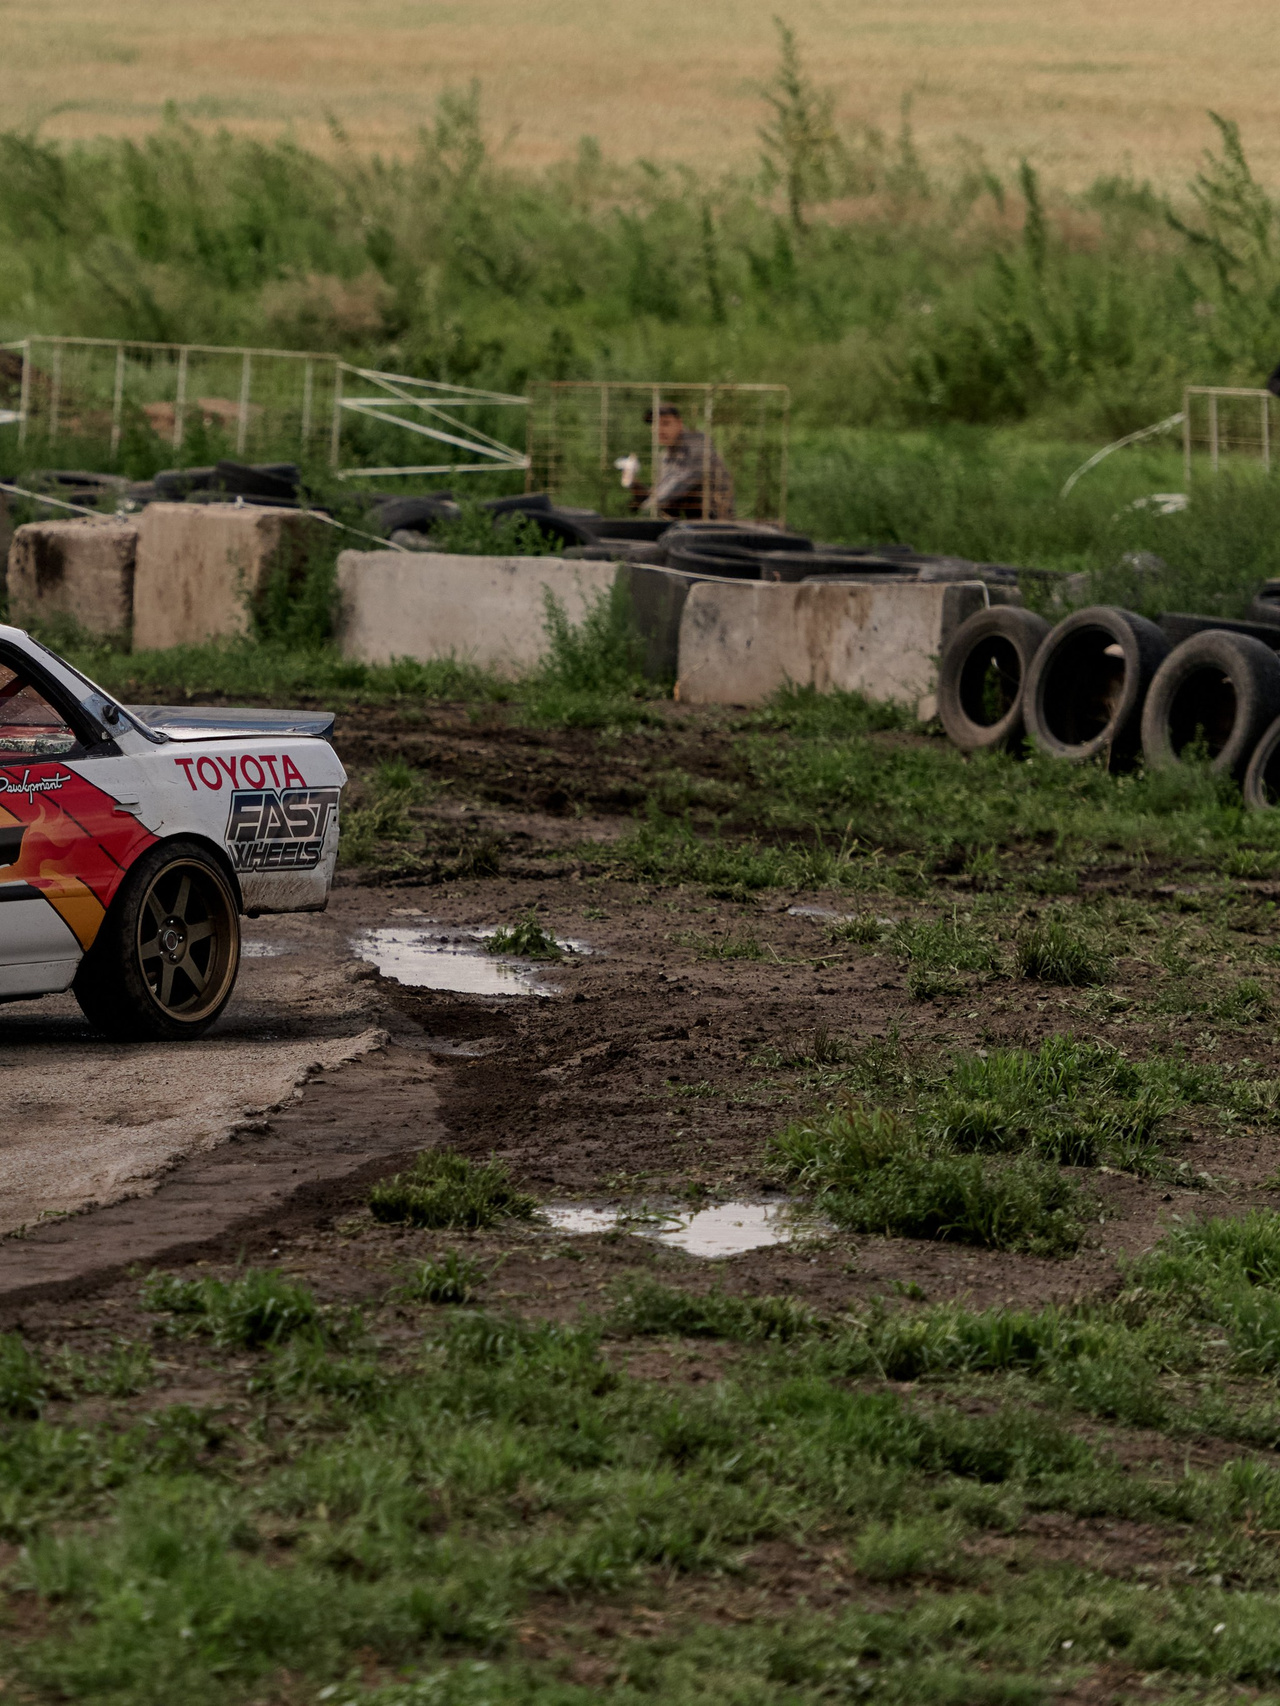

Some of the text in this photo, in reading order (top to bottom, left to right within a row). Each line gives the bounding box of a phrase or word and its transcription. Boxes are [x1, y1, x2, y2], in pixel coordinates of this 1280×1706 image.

[174, 754, 307, 791] TOYOTA
[225, 790, 338, 842] FAST
[227, 841, 322, 869] WHEELS
